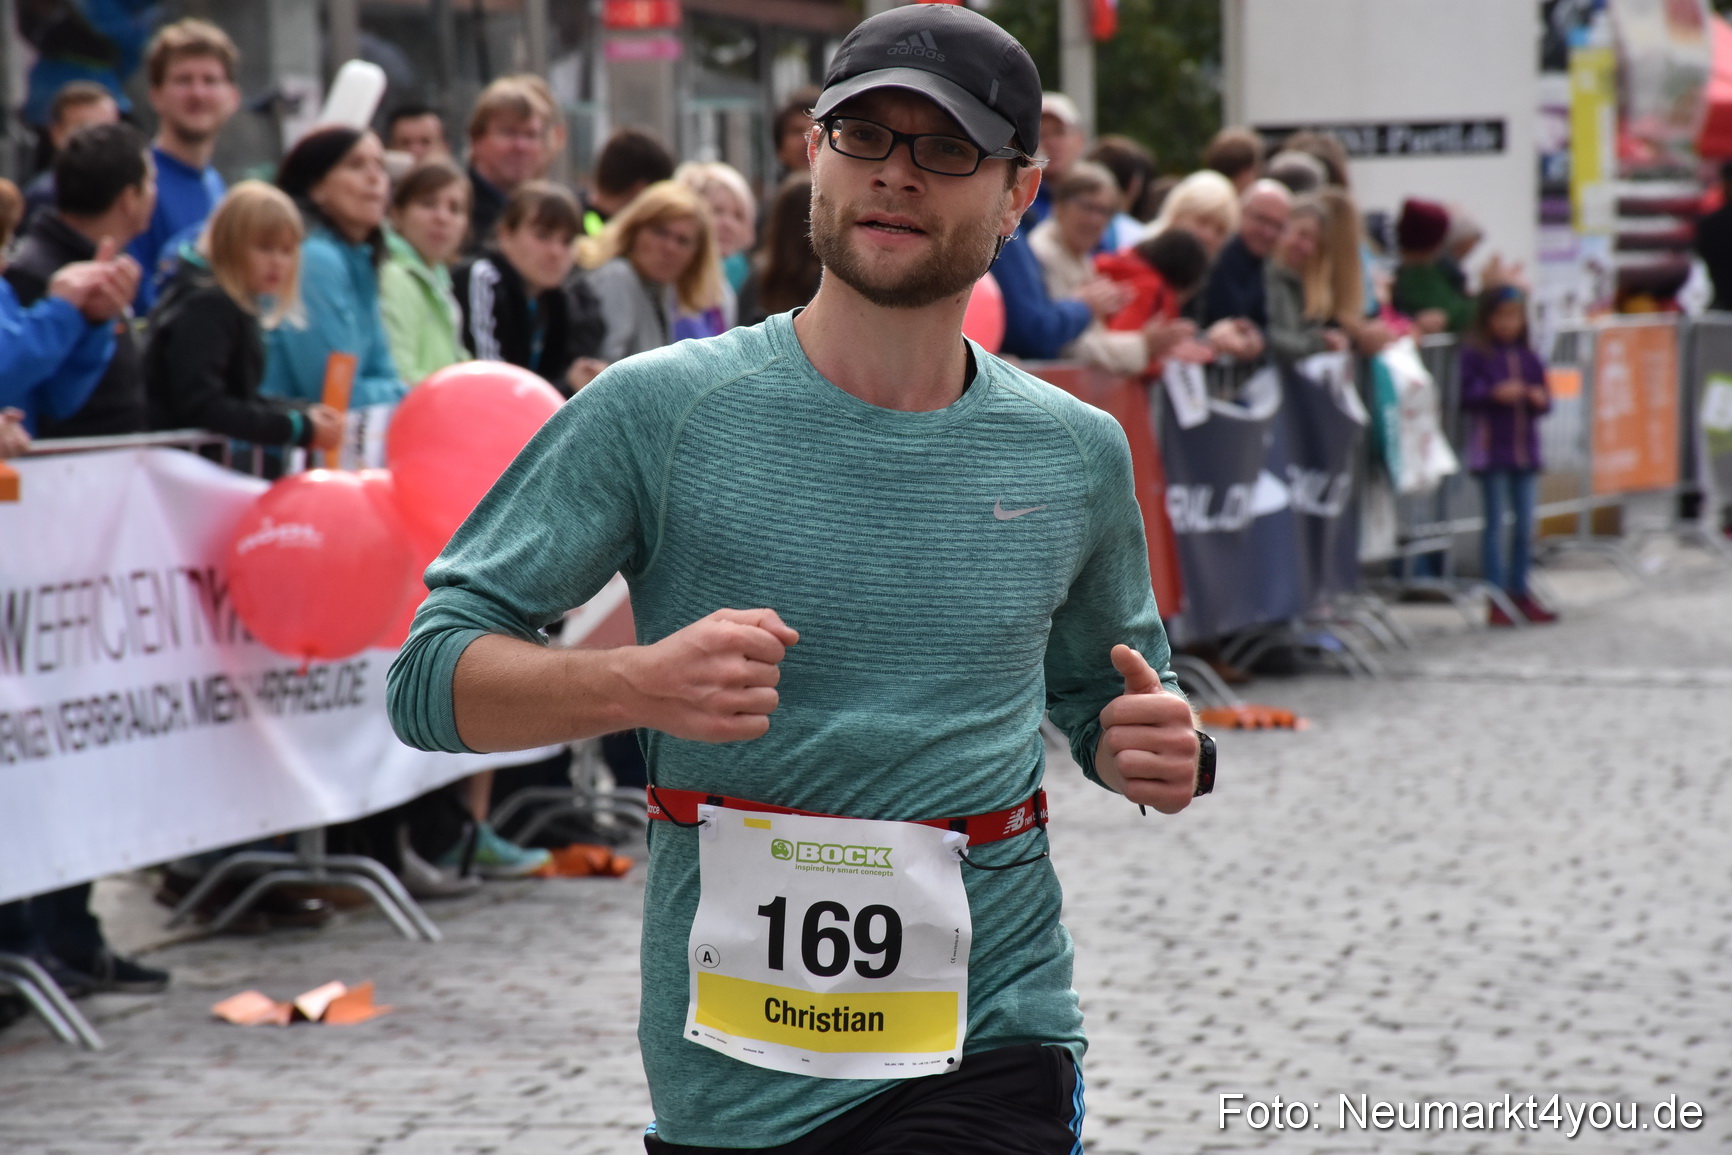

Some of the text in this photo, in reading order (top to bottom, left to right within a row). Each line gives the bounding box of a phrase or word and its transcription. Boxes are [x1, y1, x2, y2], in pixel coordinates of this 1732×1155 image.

[886, 44, 946, 63] adidas
[796, 841, 893, 869] BOCK
[795, 863, 894, 877] inspired by smart concepts
[757, 896, 903, 979] 169
[703, 951, 713, 963] A
[764, 997, 884, 1033] Christian
